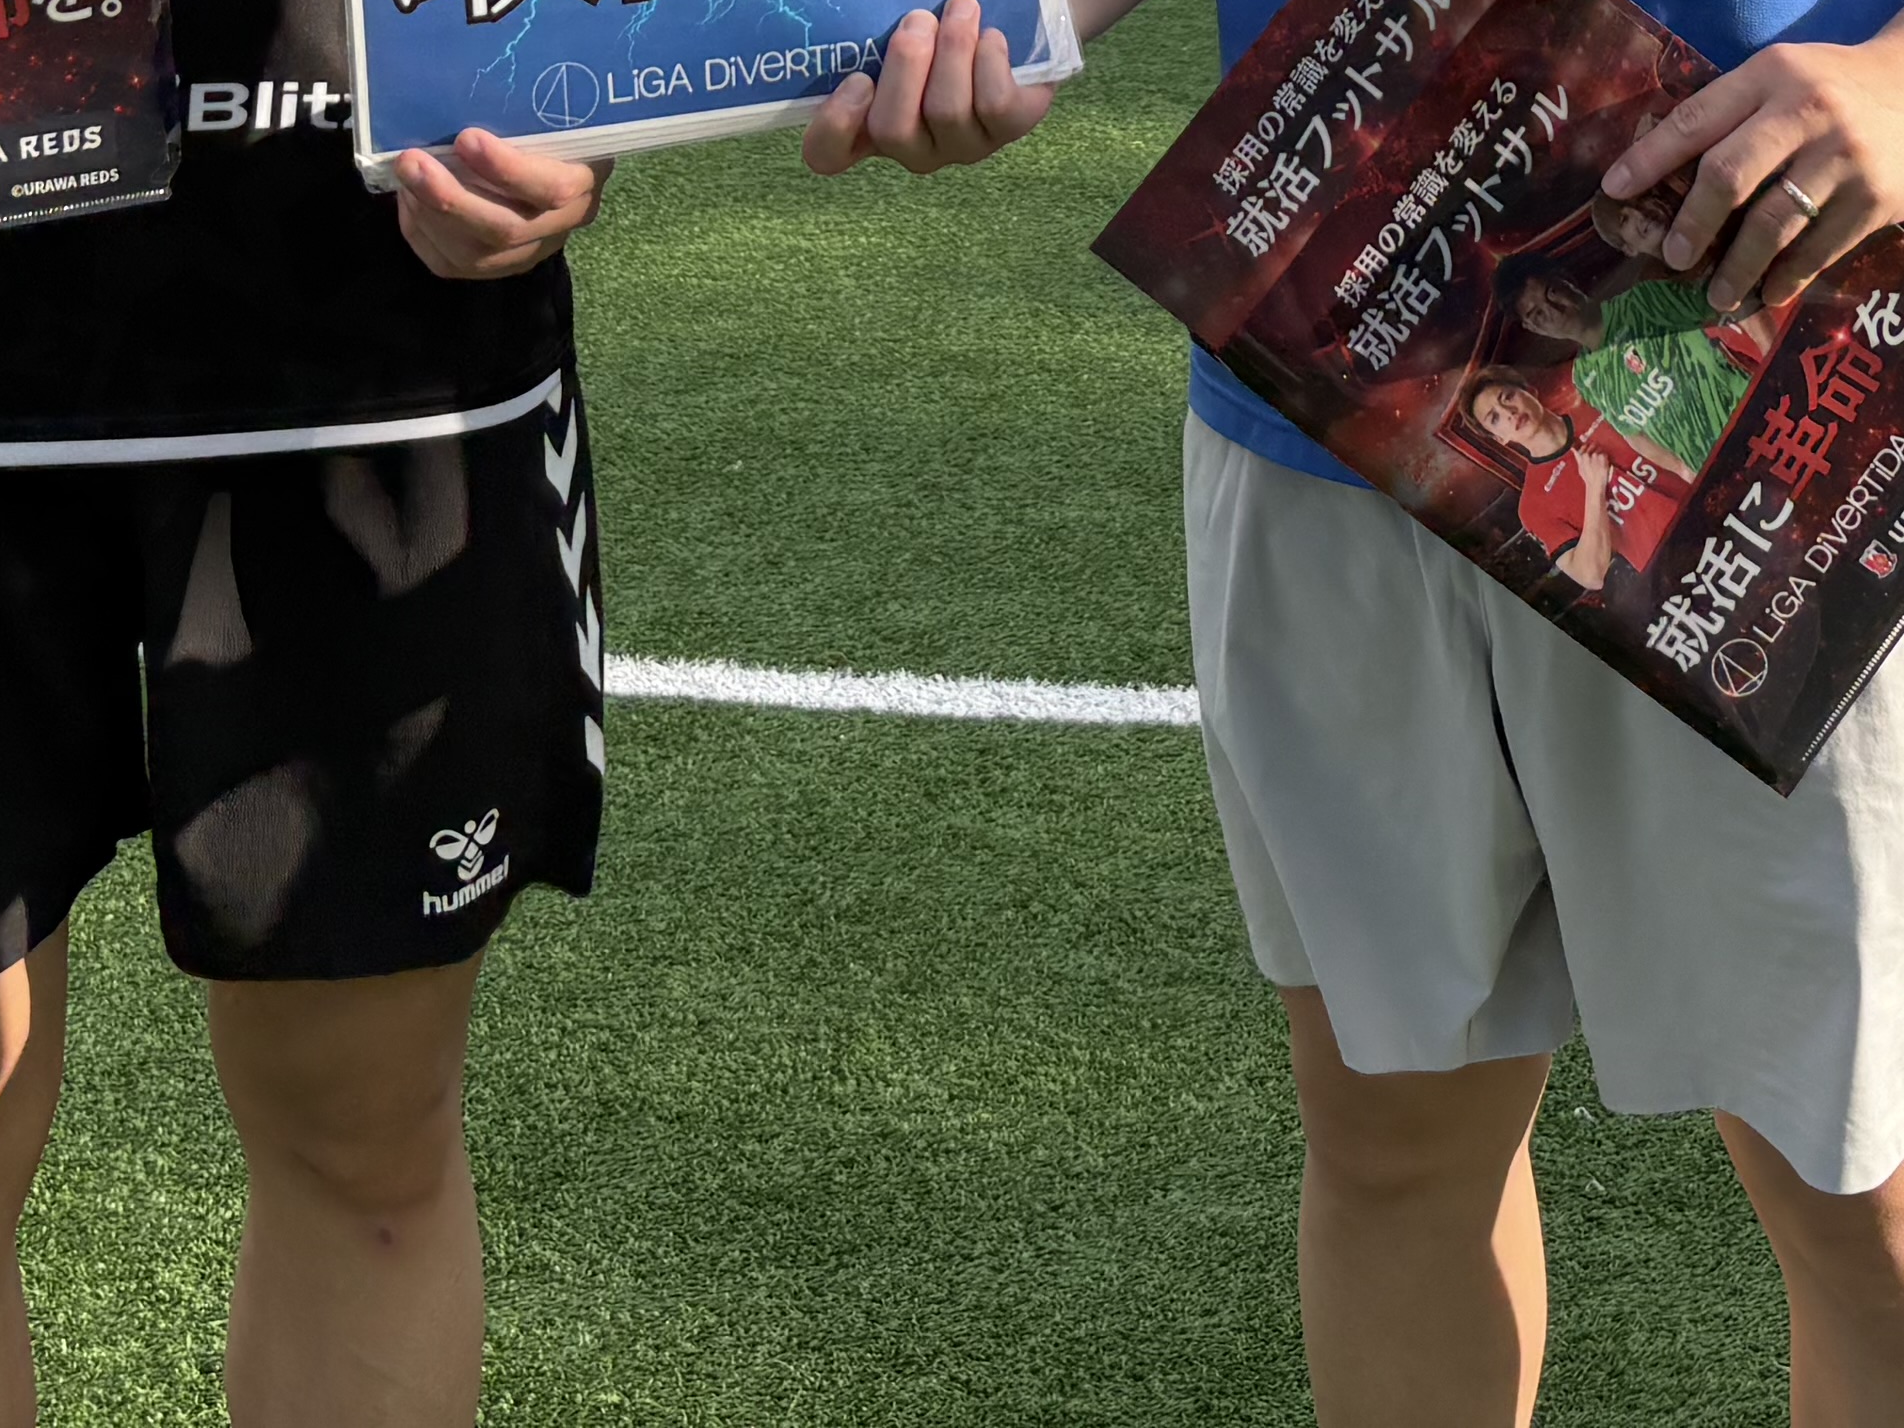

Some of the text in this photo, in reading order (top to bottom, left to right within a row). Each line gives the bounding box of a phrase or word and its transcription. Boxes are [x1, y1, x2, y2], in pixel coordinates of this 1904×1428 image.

[187, 80, 353, 132] Blit
[20, 125, 104, 160] REDS
[79, 167, 120, 188] REDS
[1333, 76, 1518, 310] 採用の常識を変える
[1346, 84, 1569, 372] 就活フットサル
[422, 854, 510, 918] hummel
